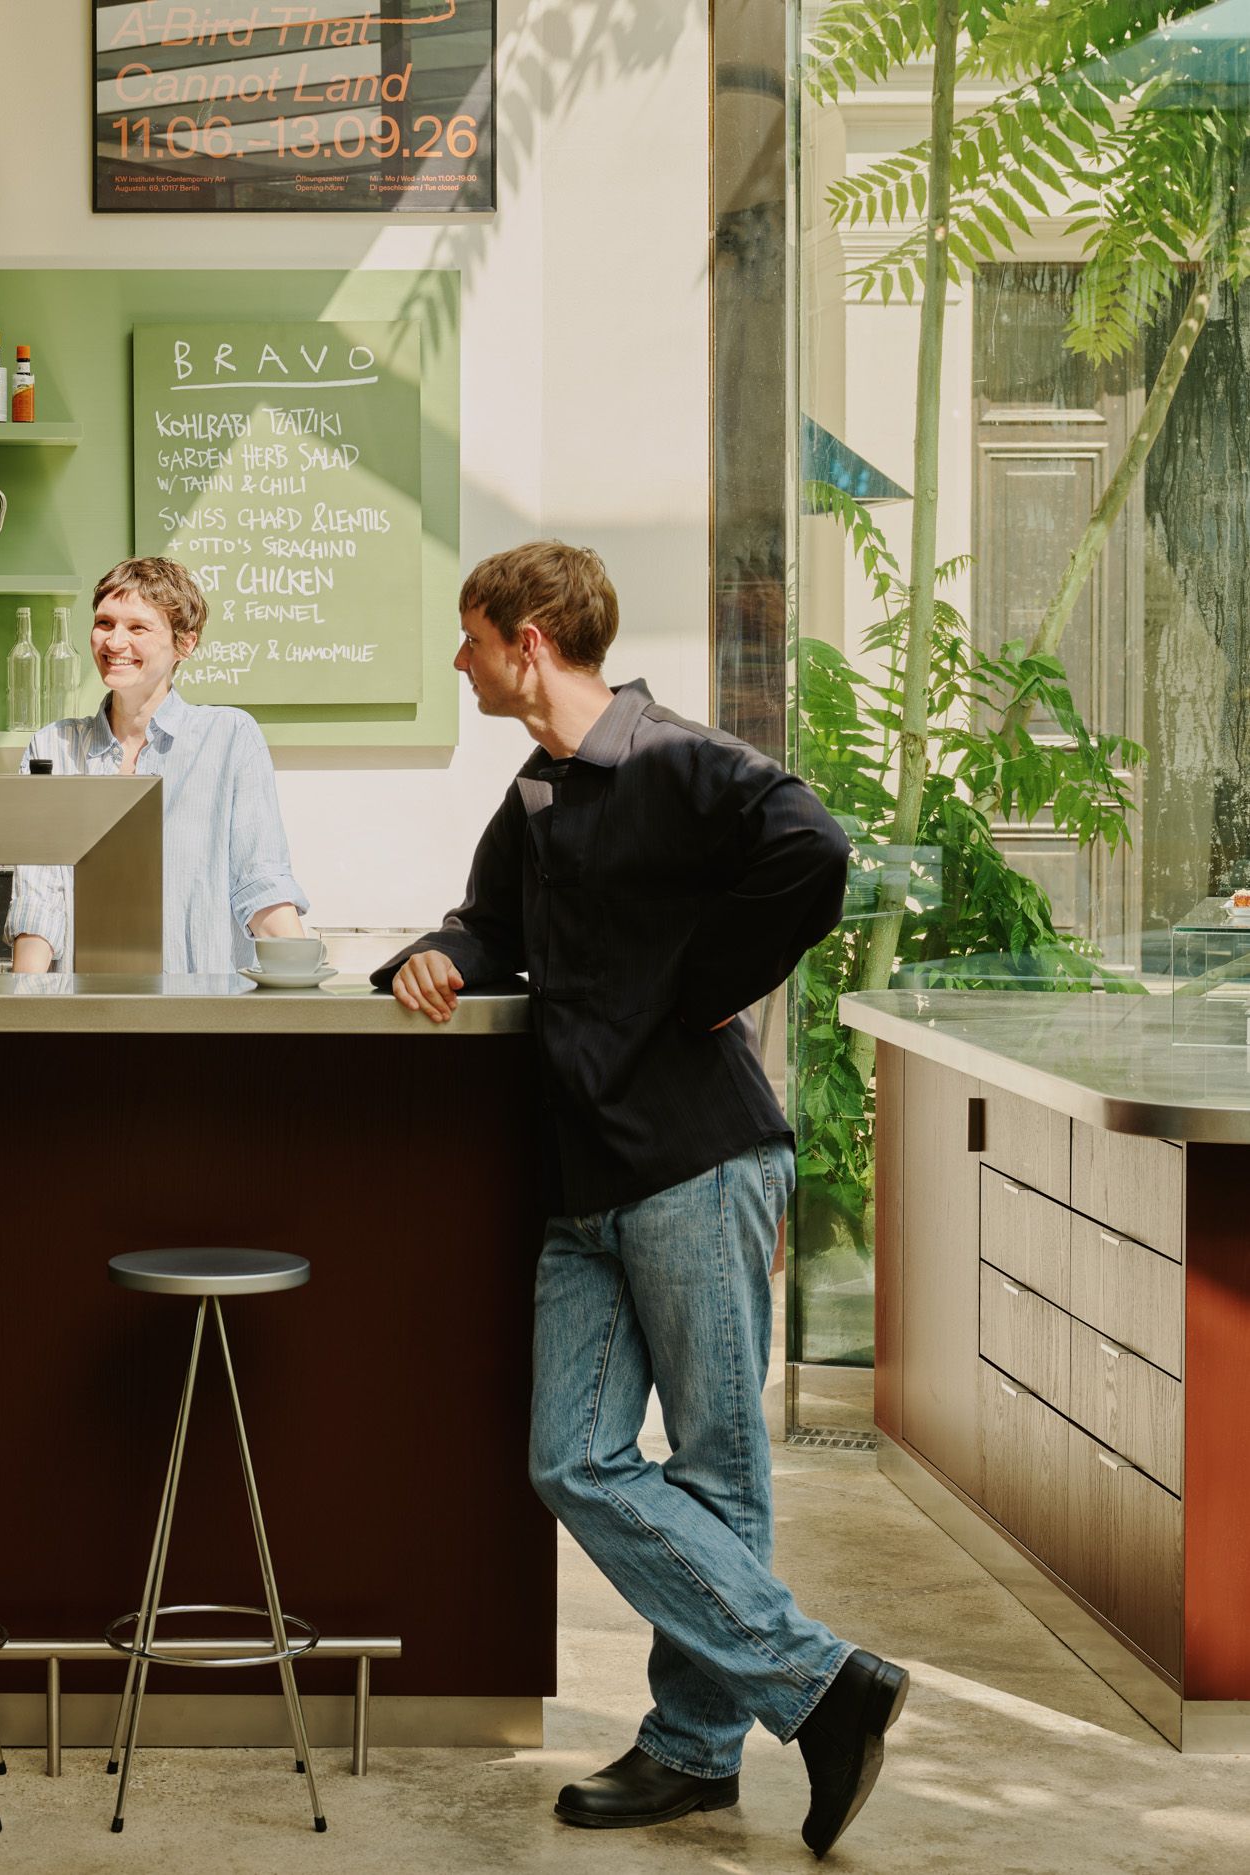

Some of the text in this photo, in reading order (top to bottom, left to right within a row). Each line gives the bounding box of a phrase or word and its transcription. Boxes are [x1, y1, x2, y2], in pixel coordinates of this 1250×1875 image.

[111, 7, 372, 47] A Bird That
[115, 62, 413, 103] Cannot Land
[166, 176, 213, 185] Contemporary
[173, 340, 375, 380] BRAVO
[155, 407, 343, 443] KOHLRABI TZATZIKI
[157, 443, 360, 472] GARDEN HERB SALAD
[157, 474, 306, 496] W/ TAHIN & CHILI
[157, 506, 226, 532] SWISS
[237, 506, 303, 532] CHARD
[189, 537, 252, 554] OTTO'S
[191, 563, 334, 596] AST CHICKEN
[222, 600, 326, 624] & FENNEL
[266, 639, 281, 661] &
[285, 642, 379, 665] CHAMOMILLE
